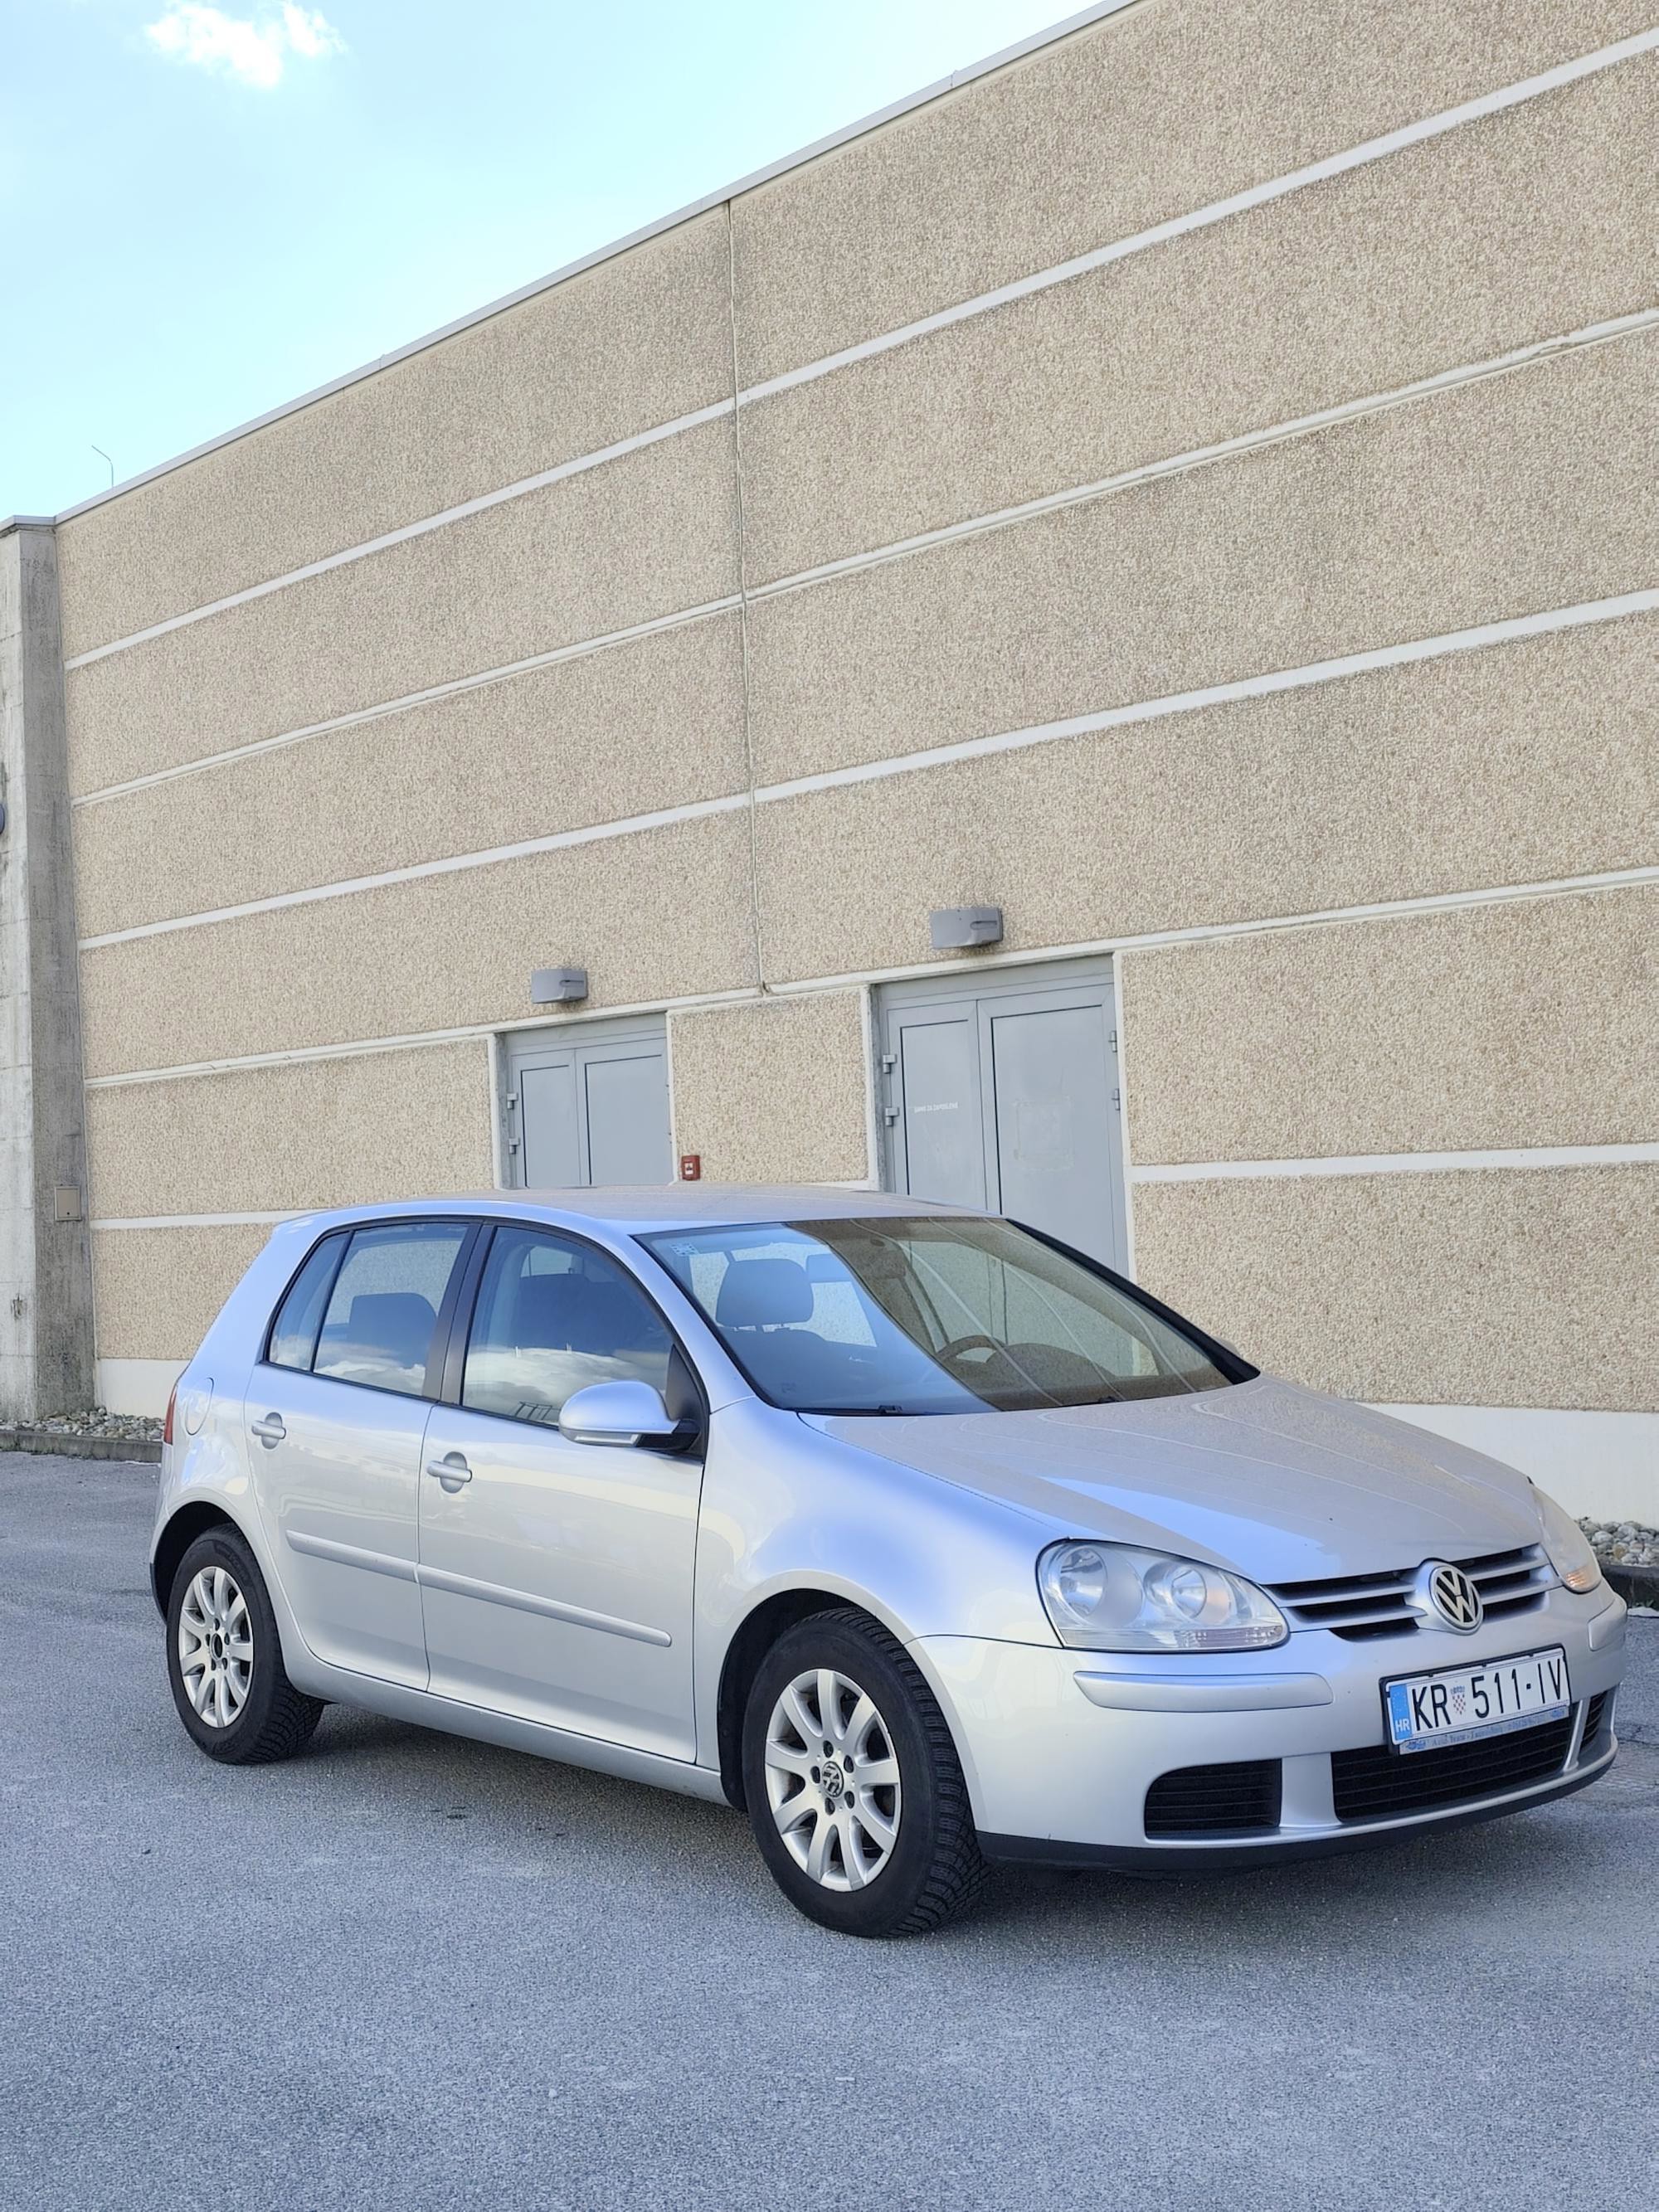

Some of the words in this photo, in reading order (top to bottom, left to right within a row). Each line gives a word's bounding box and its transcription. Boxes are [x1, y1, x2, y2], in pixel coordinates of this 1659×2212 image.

[1431, 1566, 1480, 1629] VW
[1394, 1718, 1410, 1733] HR
[1411, 1683, 1452, 1732] KR
